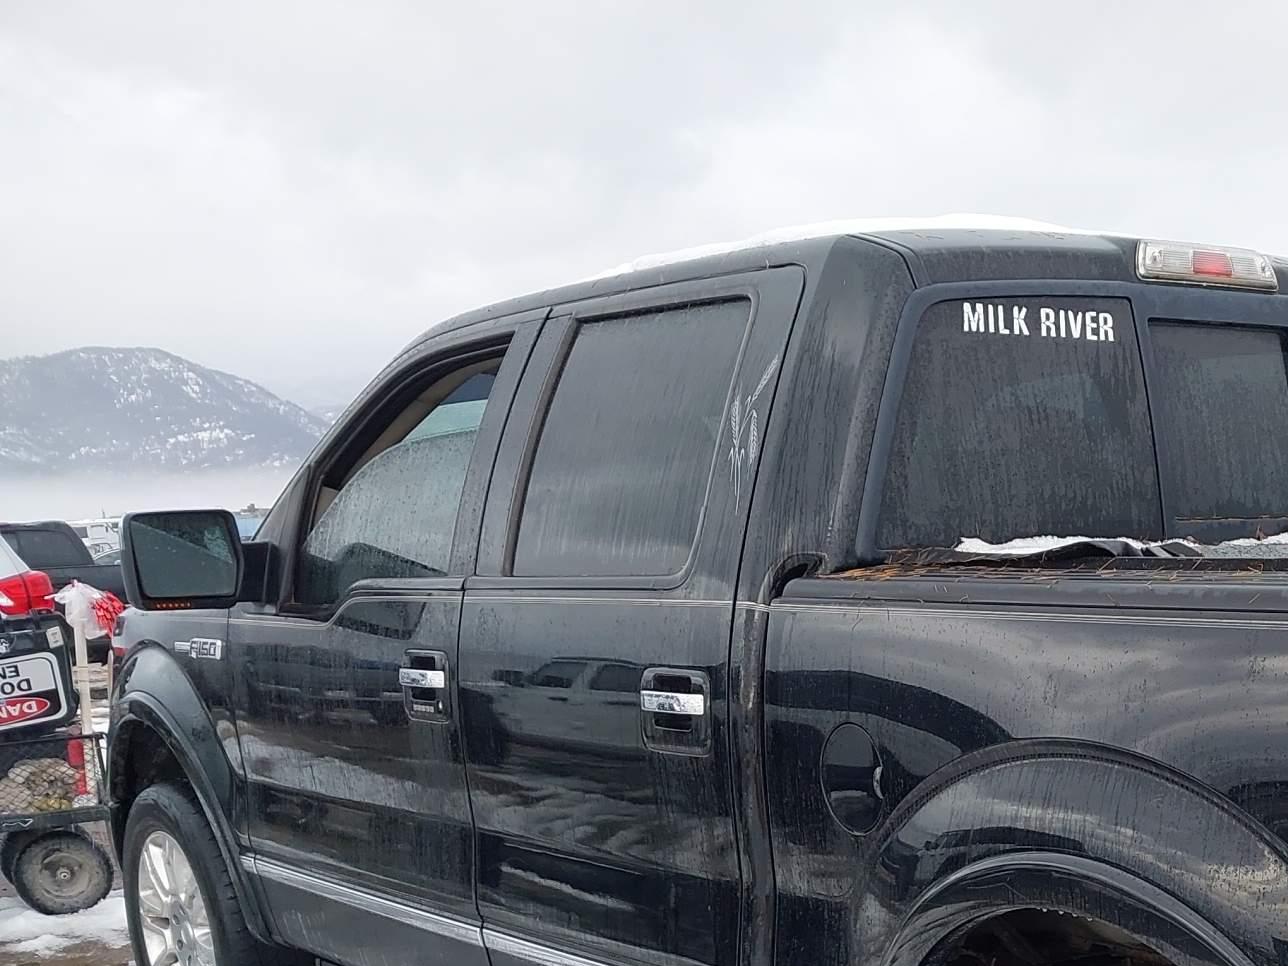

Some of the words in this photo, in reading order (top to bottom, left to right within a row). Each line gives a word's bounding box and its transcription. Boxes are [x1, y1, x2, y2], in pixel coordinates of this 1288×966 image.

[963, 302, 1030, 336] MILK
[1040, 307, 1114, 341] RIVER
[0, 678, 32, 695] DO
